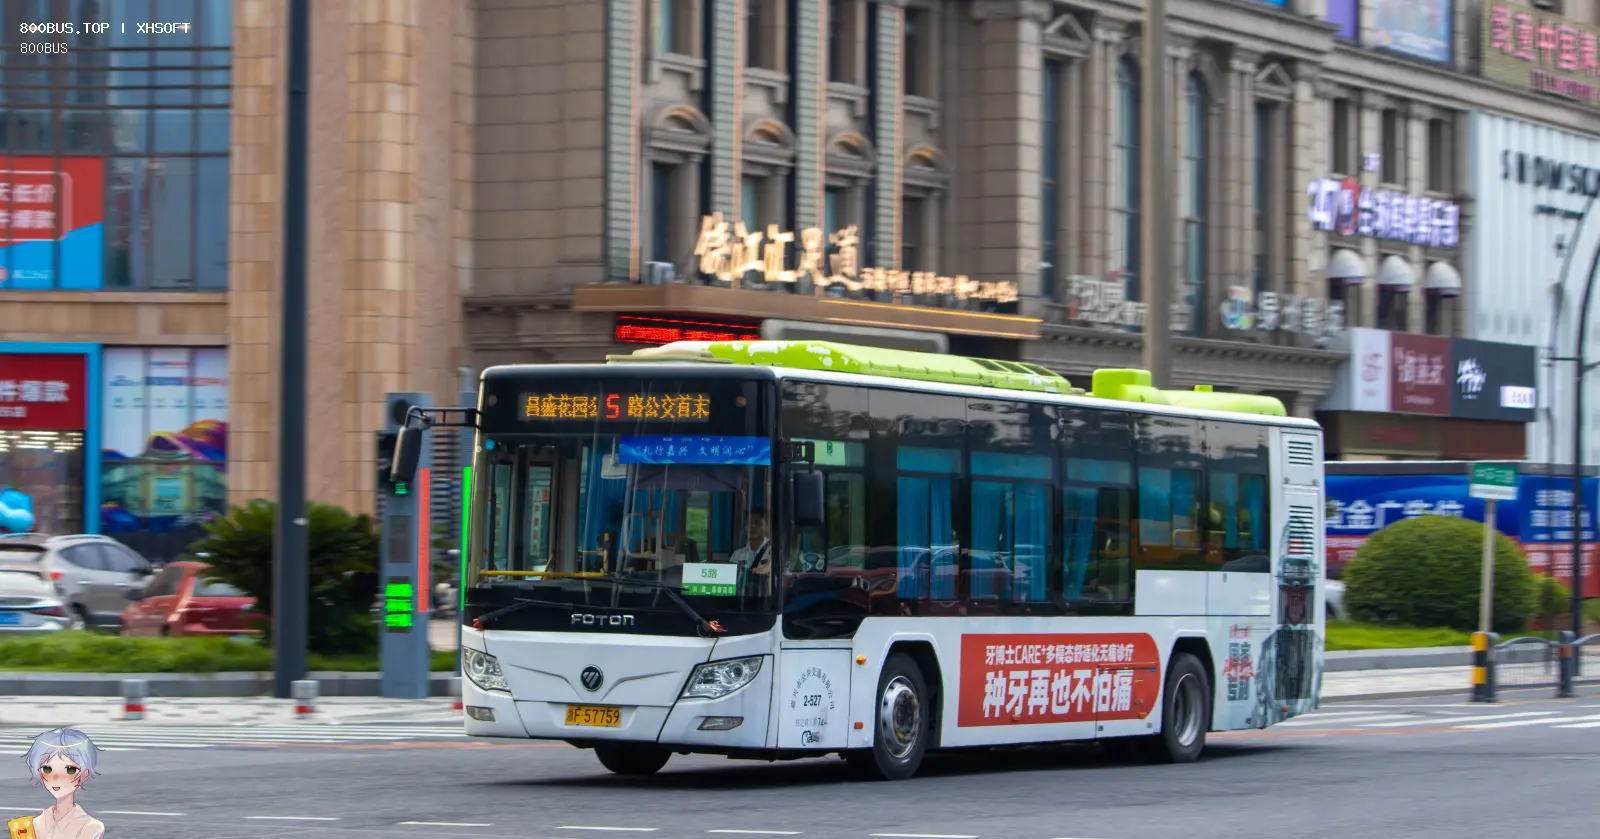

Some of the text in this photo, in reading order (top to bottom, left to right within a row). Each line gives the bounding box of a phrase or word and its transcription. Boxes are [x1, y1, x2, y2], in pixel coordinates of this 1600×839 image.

[606, 393, 620, 419] 5
[701, 568, 718, 579] 5路
[571, 613, 634, 626] FOTON
[982, 667, 1134, 718] 种牙再也不怕痛
[803, 694, 821, 707] 2-527
